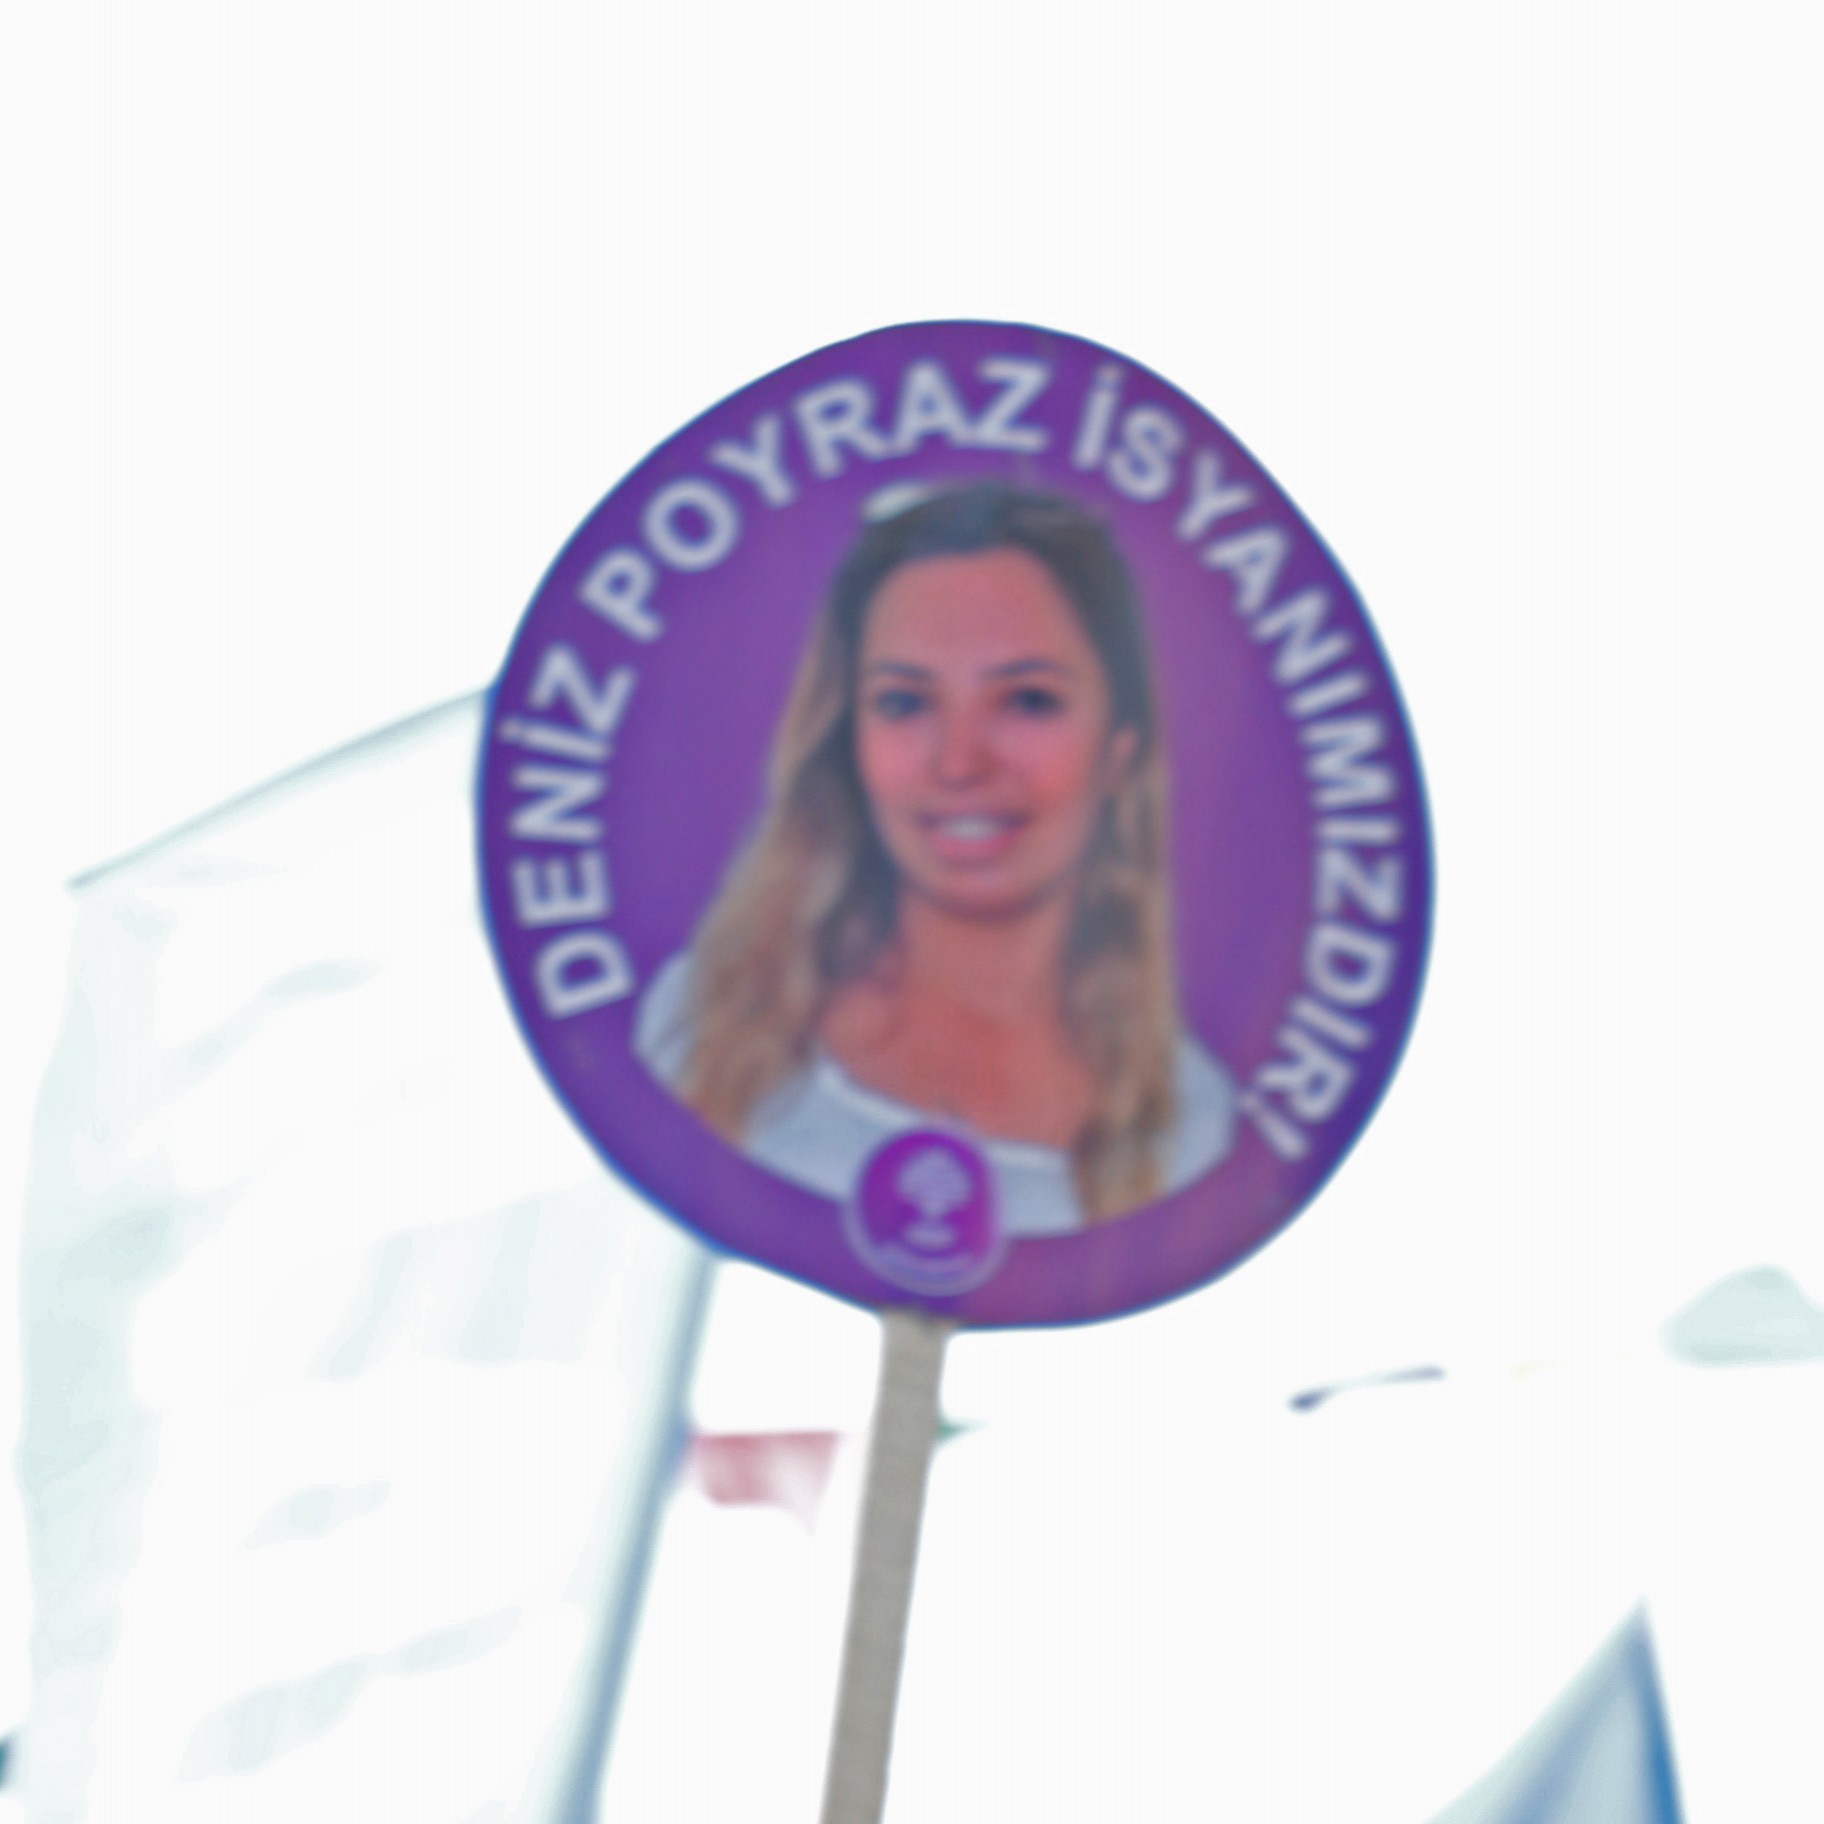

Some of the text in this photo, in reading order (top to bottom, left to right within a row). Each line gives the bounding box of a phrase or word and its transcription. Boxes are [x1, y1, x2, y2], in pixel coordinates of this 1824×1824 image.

[497, 356, 1404, 1163] DENİZ POYRAZ İSYANIMIZDIR!
